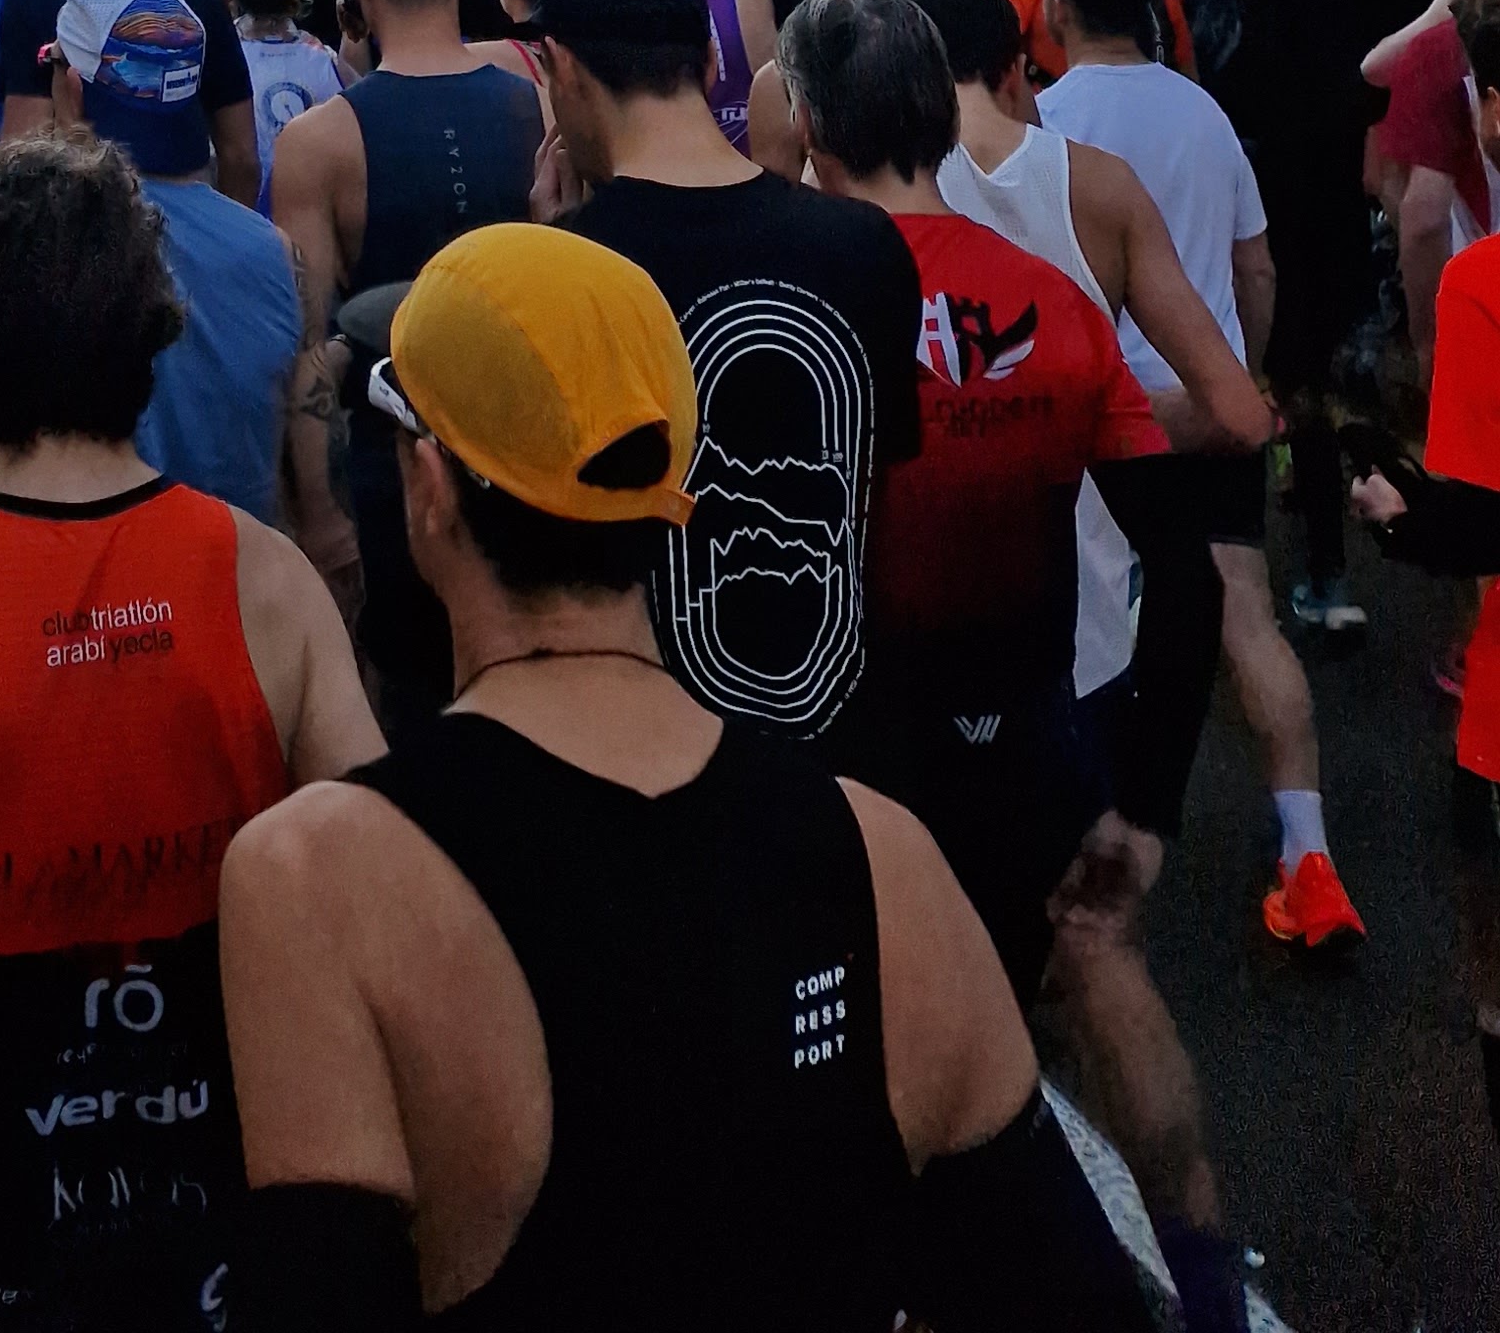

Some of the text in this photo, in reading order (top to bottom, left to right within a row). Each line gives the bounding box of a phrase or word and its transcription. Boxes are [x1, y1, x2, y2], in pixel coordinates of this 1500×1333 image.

[795, 965, 845, 1000] COMP
[795, 999, 846, 1035] RESS
[794, 1034, 845, 1069] PORT
[25, 1079, 210, 1138] verdú
